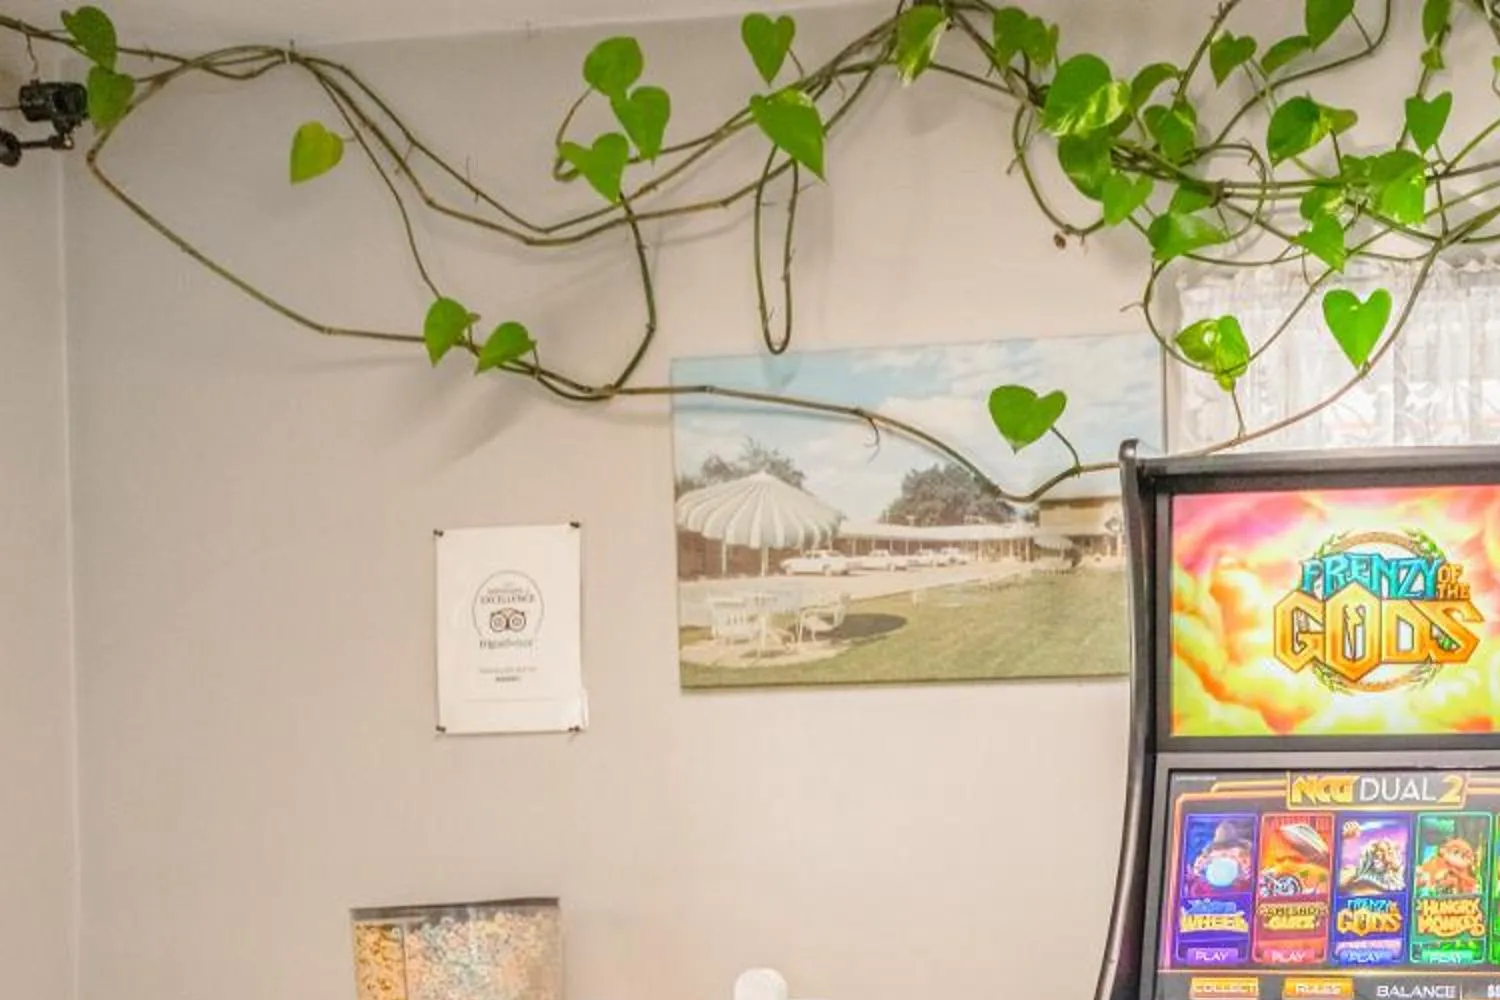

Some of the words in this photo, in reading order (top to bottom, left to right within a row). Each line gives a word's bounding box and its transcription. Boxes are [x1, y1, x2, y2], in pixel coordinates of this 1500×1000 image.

[1301, 552, 1444, 601] FRENZY
[1438, 563, 1463, 585] OF
[1438, 582, 1471, 600] THE
[1273, 583, 1485, 683] GODS
[1359, 775, 1436, 801] DUAL
[1438, 775, 1463, 803] 2
[1195, 951, 1228, 962] PLAY
[1272, 951, 1305, 962] PLAY
[1376, 985, 1456, 999] BALANCE
